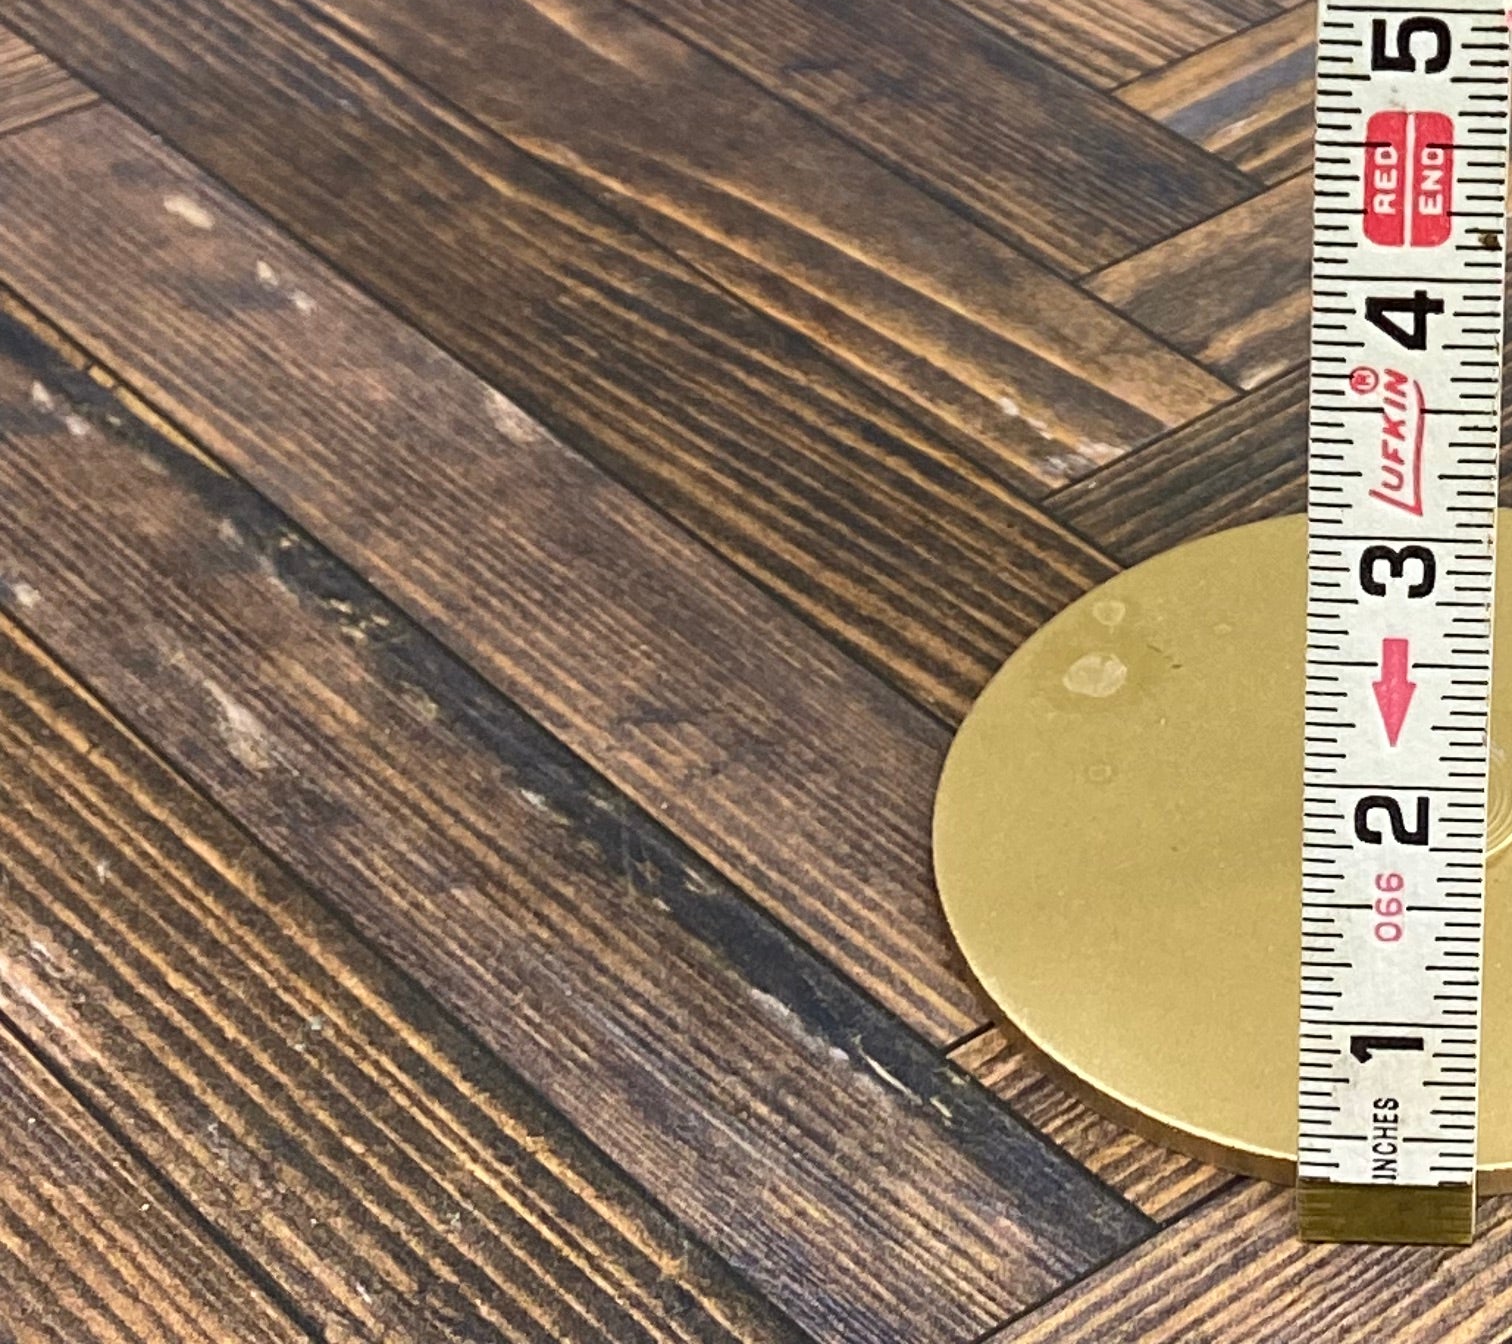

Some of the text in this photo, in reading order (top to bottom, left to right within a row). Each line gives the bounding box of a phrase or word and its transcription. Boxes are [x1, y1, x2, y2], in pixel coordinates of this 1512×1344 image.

[1370, 15, 1452, 74] 5
[1372, 144, 1399, 216] RED
[1418, 146, 1444, 217] END
[1364, 289, 1445, 351] 4
[1368, 367, 1426, 518] LUFKIN
[1359, 544, 1437, 599] 3
[1353, 794, 1430, 846] 2
[1350, 1035, 1424, 1064] 1
[1371, 1097, 1400, 1180] INCHES
